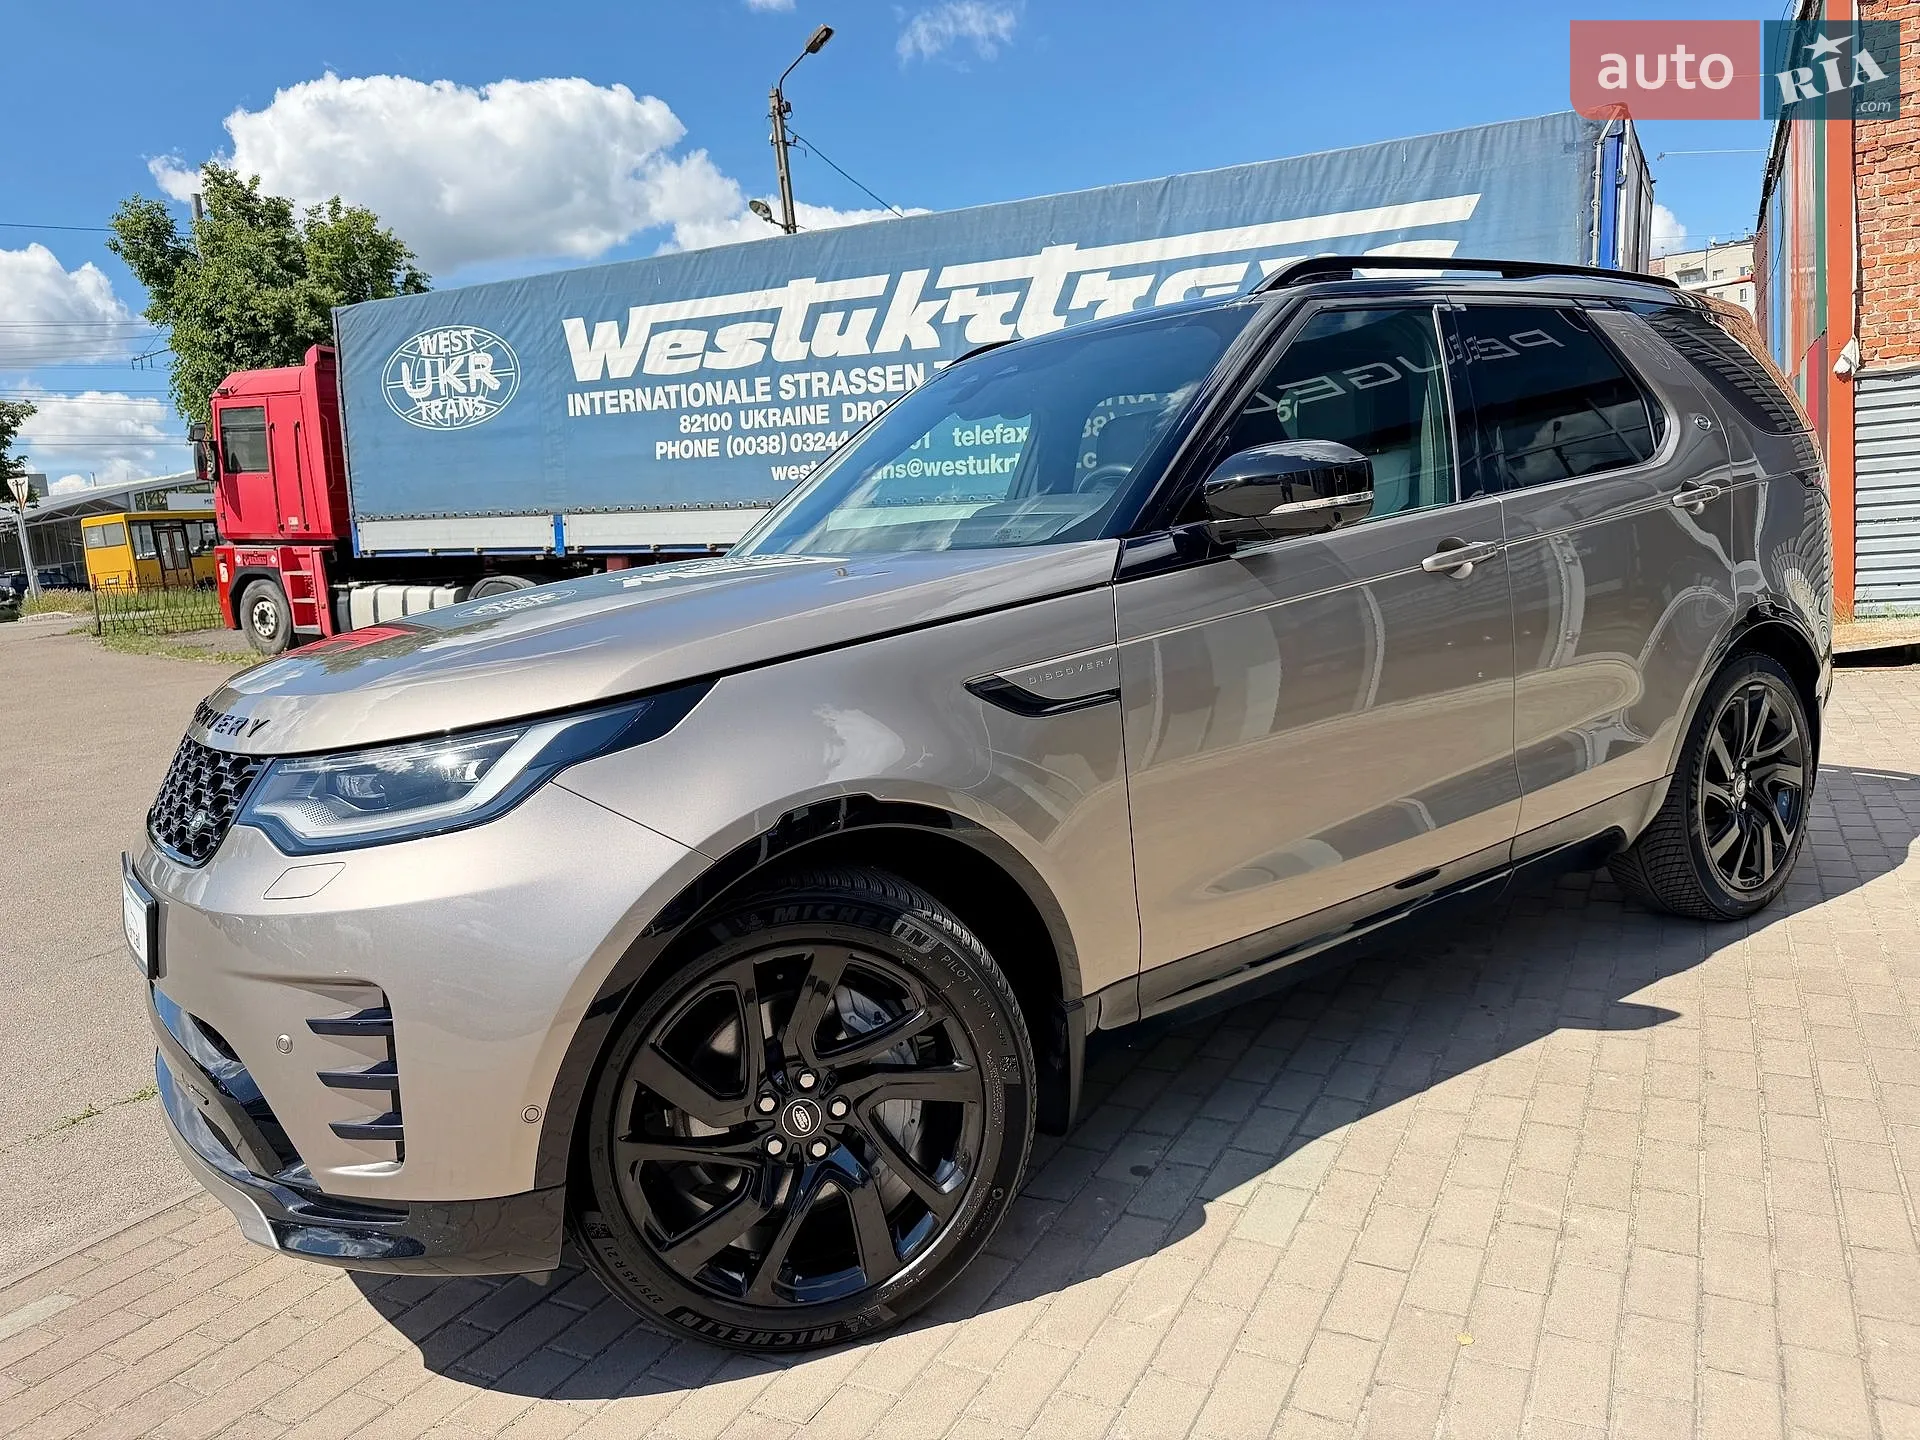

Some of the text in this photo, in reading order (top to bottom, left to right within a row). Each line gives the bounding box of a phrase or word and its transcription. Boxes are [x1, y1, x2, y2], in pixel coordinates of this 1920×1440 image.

[417, 328, 476, 356] WEST
[401, 351, 501, 400] UKR
[566, 362, 926, 417] INTERNATIONALE STRASSEN
[418, 396, 487, 421] TRANS
[679, 399, 896, 434] 82100 UKRAINE DRO
[655, 437, 720, 461] PHONE
[952, 423, 1030, 448] telefax
[1028, 656, 1113, 686] DISCOVERY
[772, 903, 933, 949] MICHELIN
[941, 953, 974, 985] PILOT
[623, 1271, 664, 1304] 275/45
[676, 1310, 839, 1346] MICHELIN
